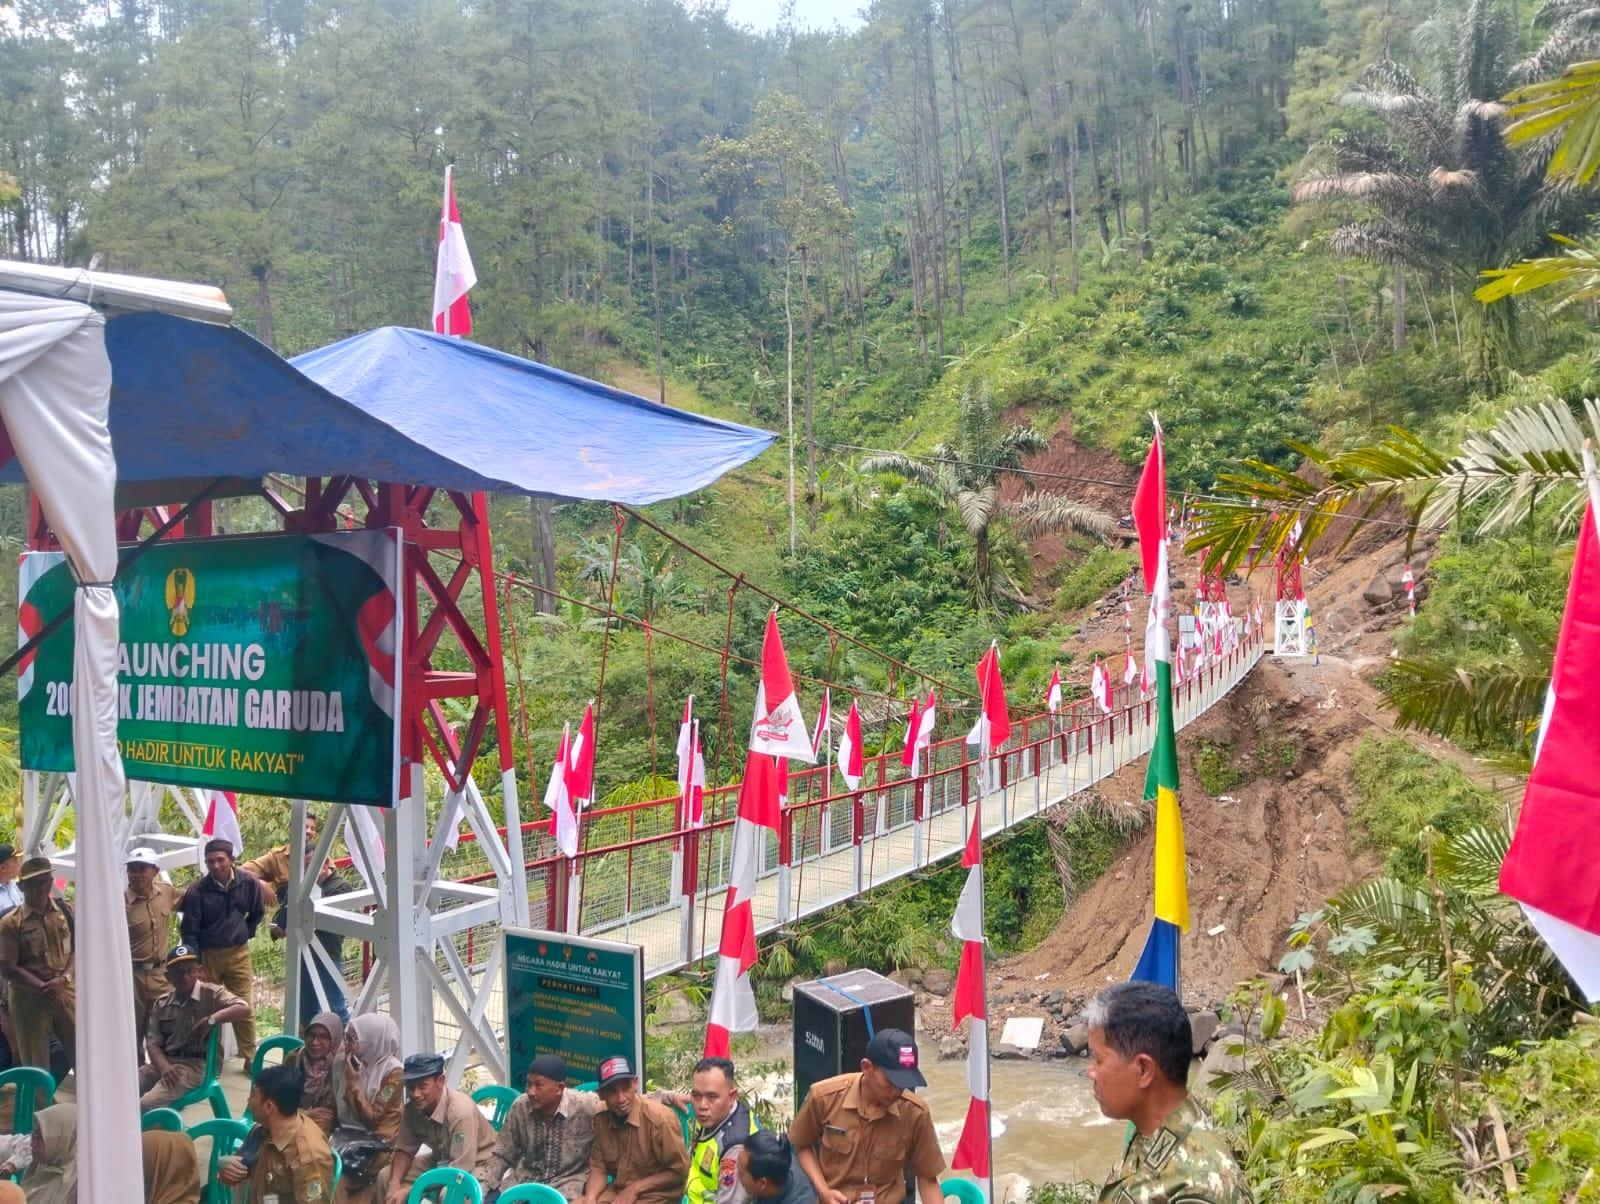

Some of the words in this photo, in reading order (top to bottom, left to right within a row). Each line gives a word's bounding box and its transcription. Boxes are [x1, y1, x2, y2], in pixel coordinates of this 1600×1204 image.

[118, 643, 265, 681] AUNCHING
[136, 686, 239, 728] JEMBATAN
[245, 690, 344, 732] GARUDA
[126, 740, 168, 763] HADIR
[173, 743, 225, 769] UNTUK
[231, 750, 304, 776] RAKYAT"
[517, 954, 545, 966] NEGARA
[546, 959, 567, 970] HADIR
[568, 963, 591, 974] UNTUK
[592, 967, 622, 980] RAKYAT
